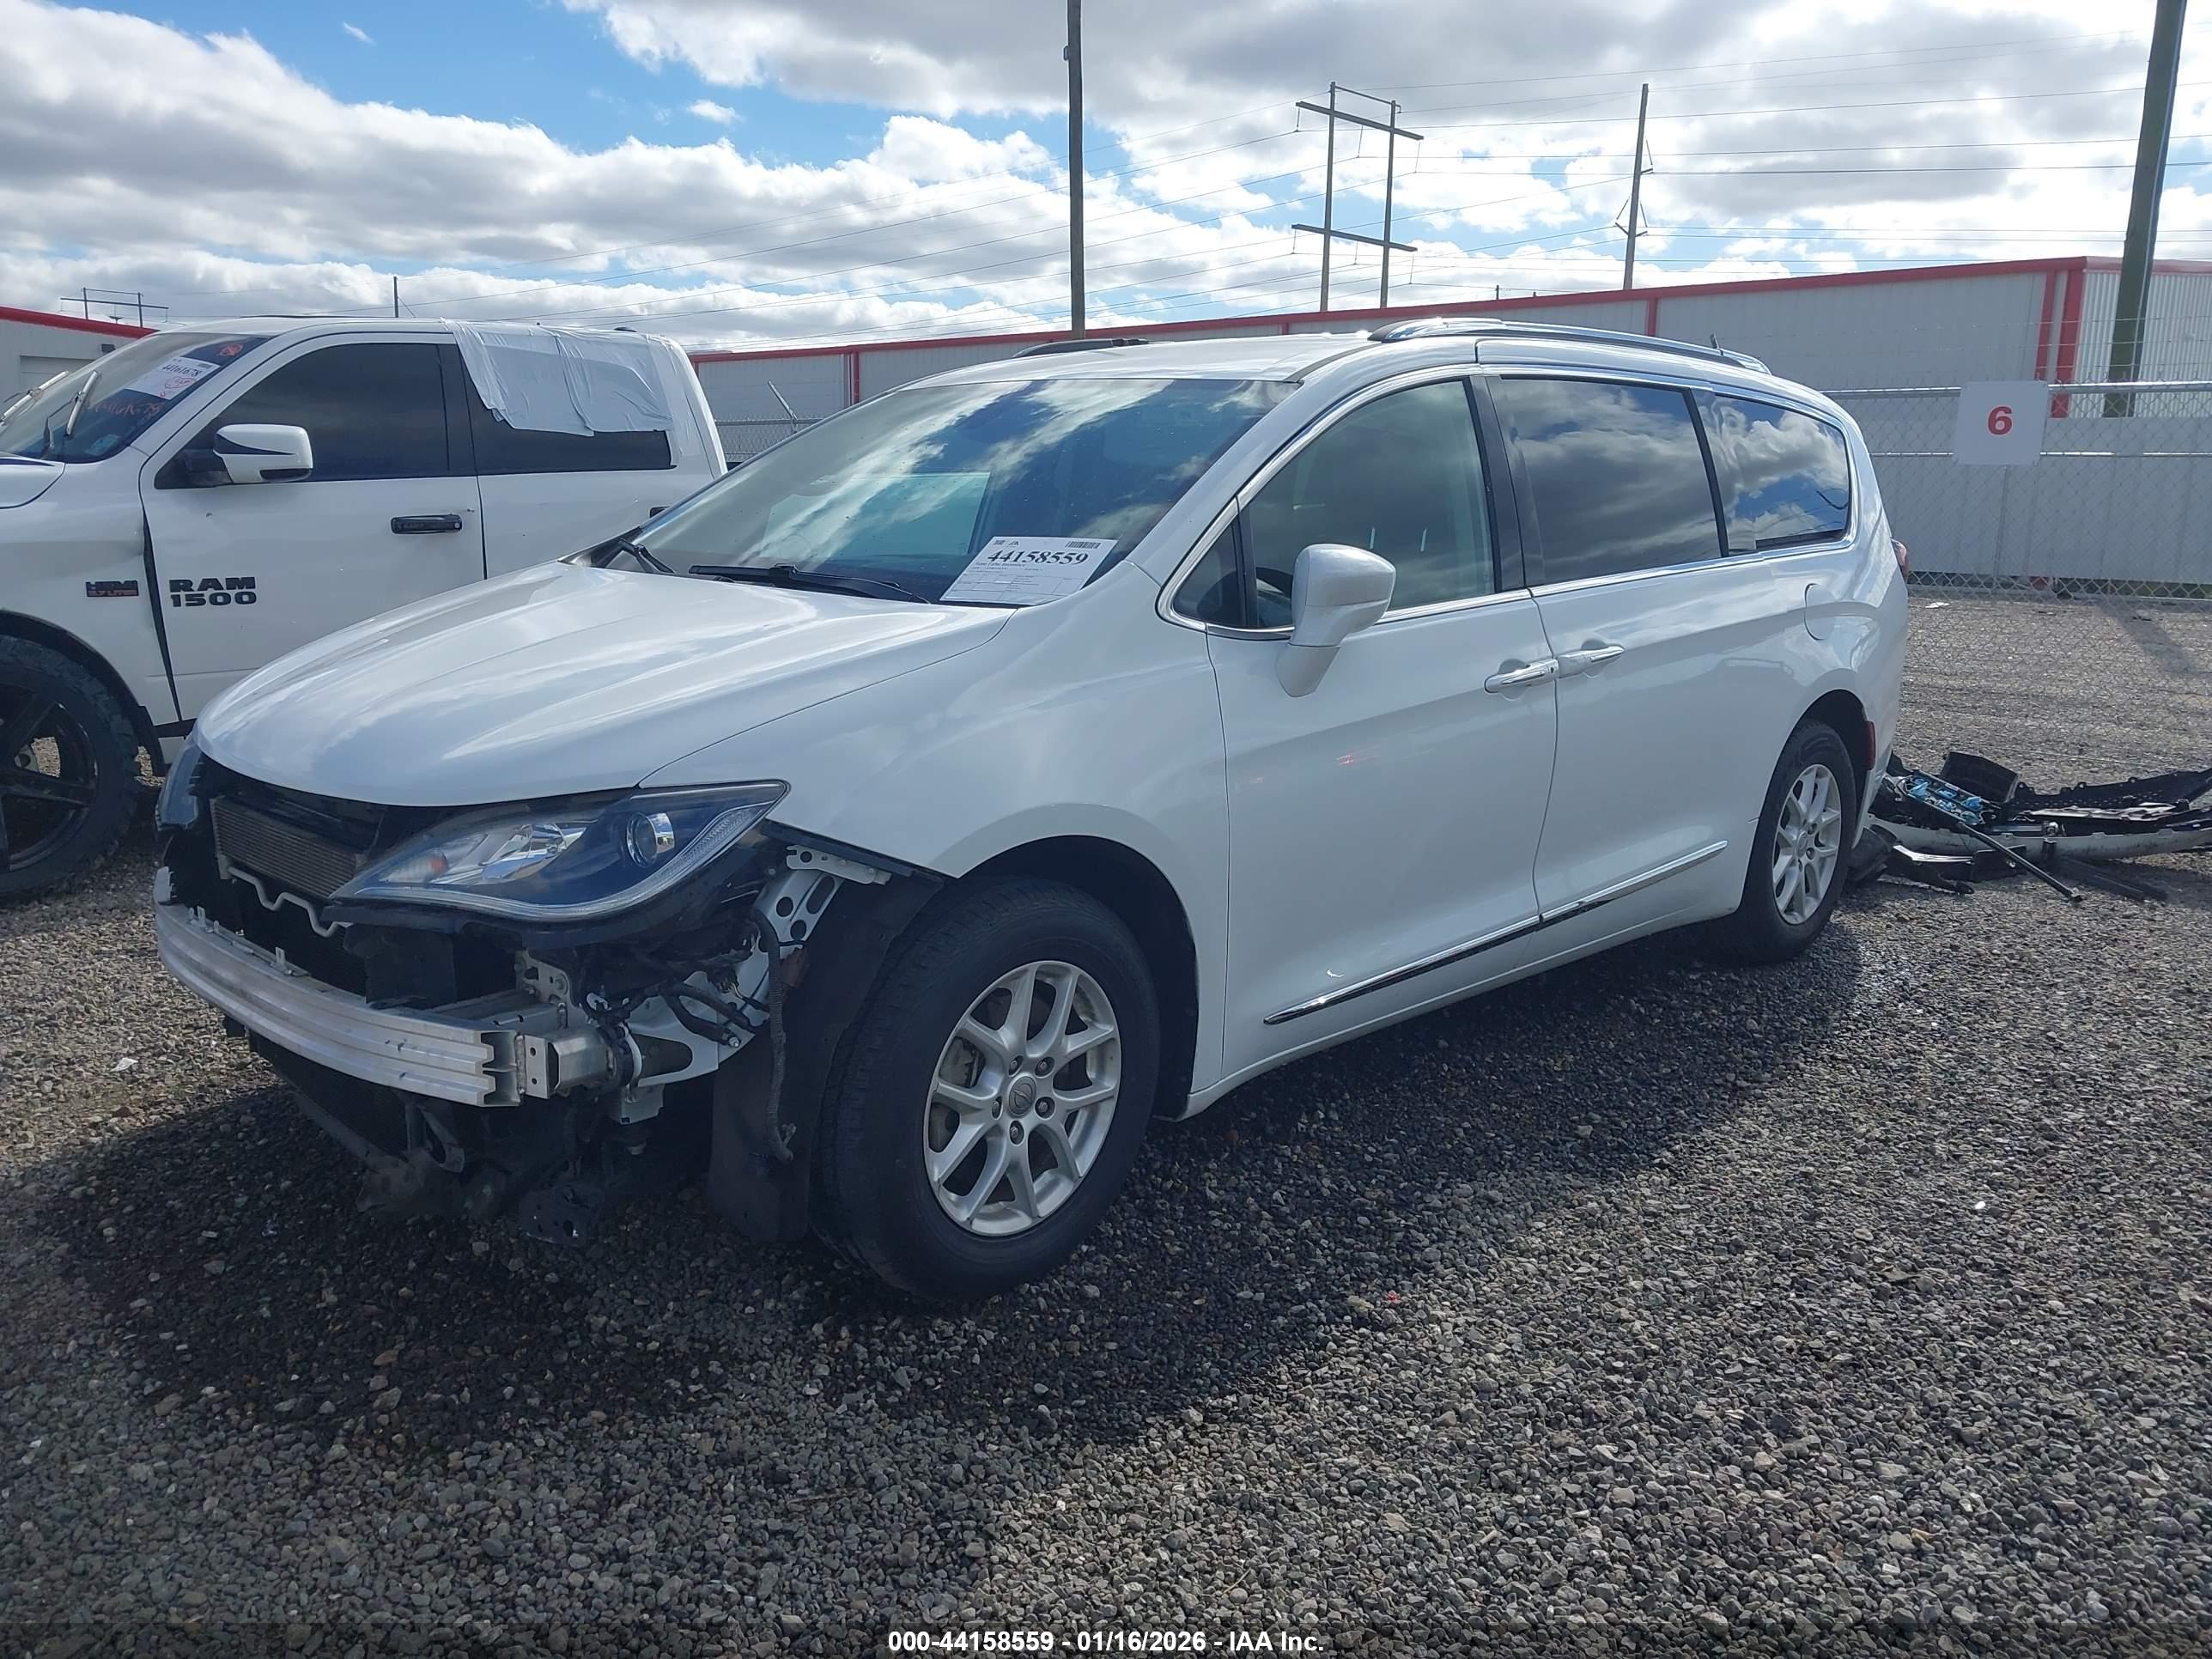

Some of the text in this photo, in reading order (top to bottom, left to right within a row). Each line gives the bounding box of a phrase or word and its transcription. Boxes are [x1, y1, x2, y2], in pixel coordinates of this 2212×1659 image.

[1987, 405, 2013, 435] 6
[987, 550, 1089, 565] 44158559
[168, 576, 256, 592] RAM
[170, 591, 258, 608] 1500
